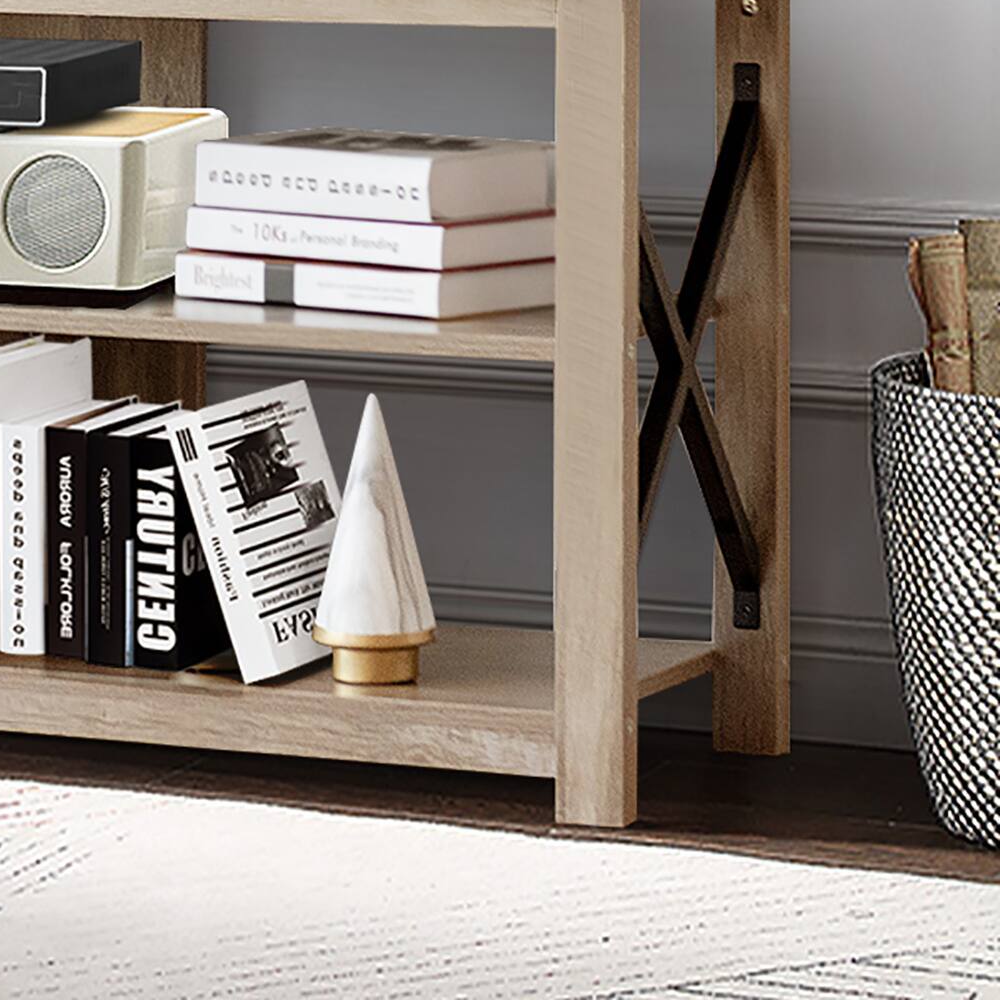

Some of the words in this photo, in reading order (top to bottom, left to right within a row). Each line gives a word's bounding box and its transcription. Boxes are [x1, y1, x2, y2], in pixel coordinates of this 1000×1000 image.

[282, 176, 318, 192] and
[253, 223, 288, 243] 10Ks
[300, 230, 346, 247] Personal
[352, 236, 398, 253] Branding
